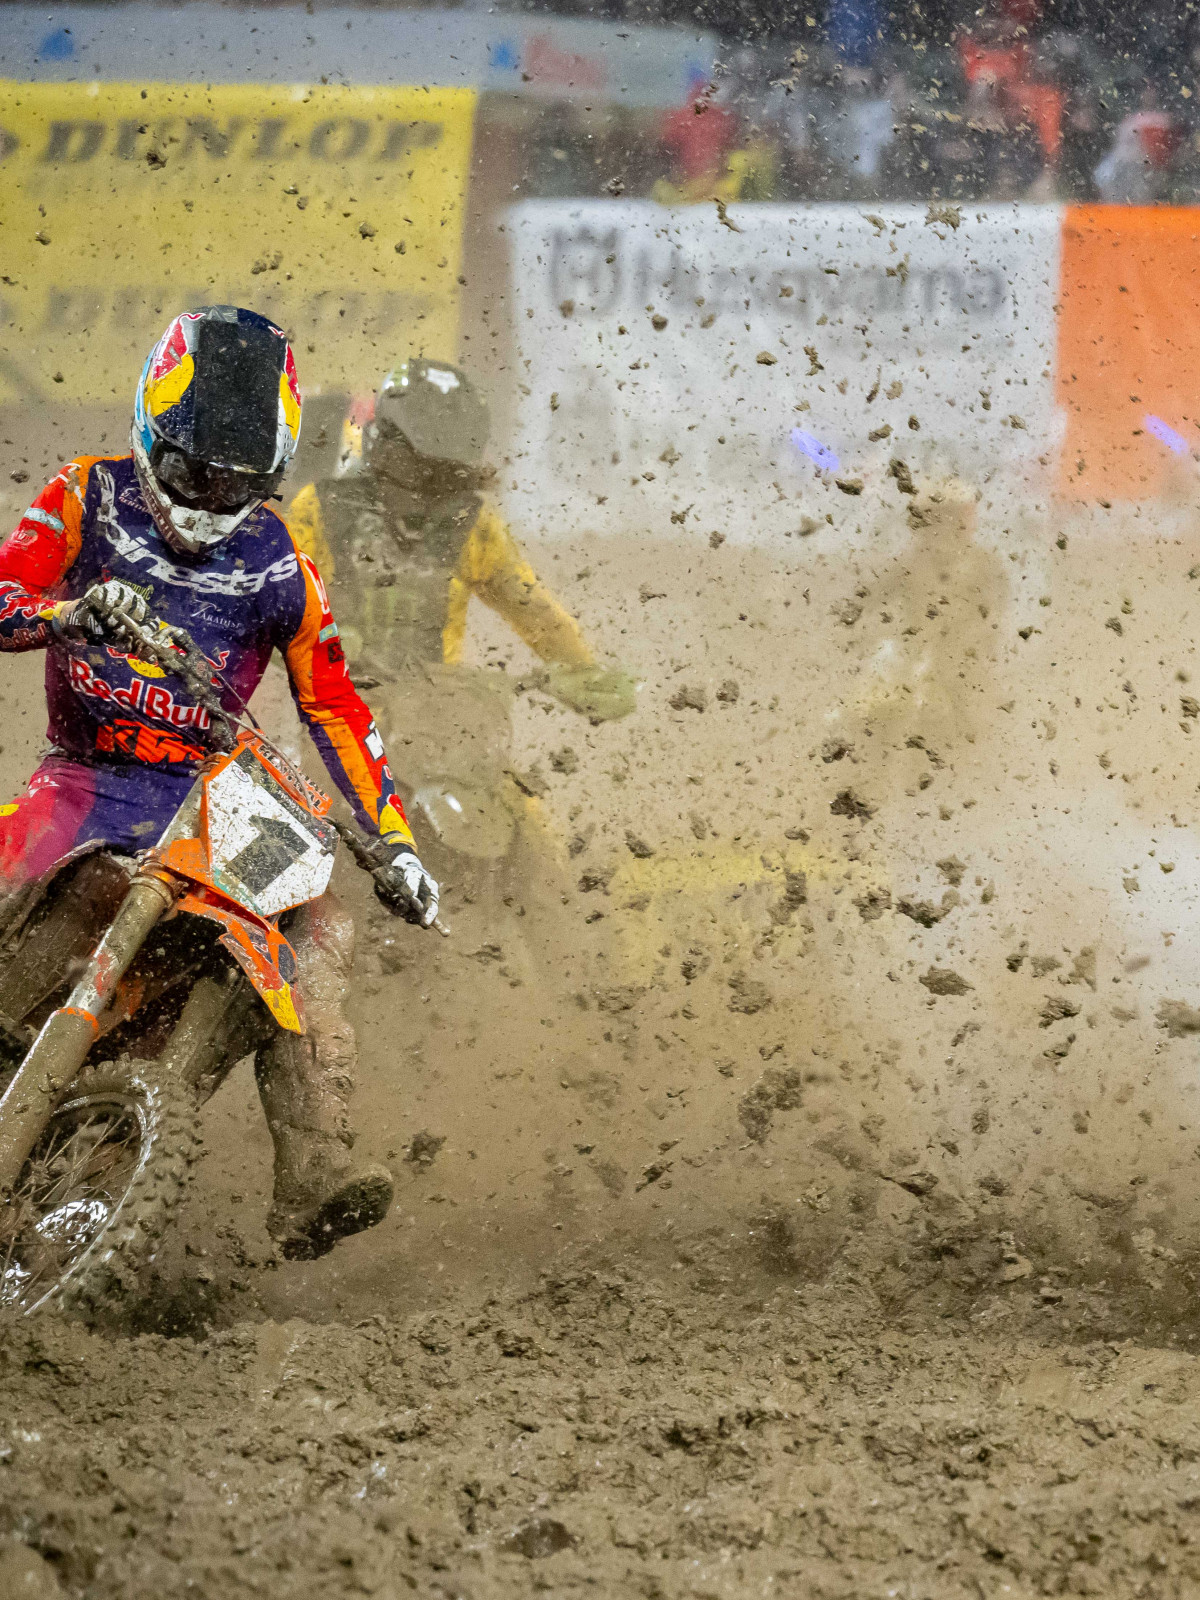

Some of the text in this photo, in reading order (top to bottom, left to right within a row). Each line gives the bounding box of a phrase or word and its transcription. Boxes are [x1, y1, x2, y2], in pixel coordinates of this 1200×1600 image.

[42, 117, 444, 163] DUNLOP
[69, 653, 211, 730] Red Bull
[96, 718, 205, 763] KTM
[224, 813, 311, 897] 1
